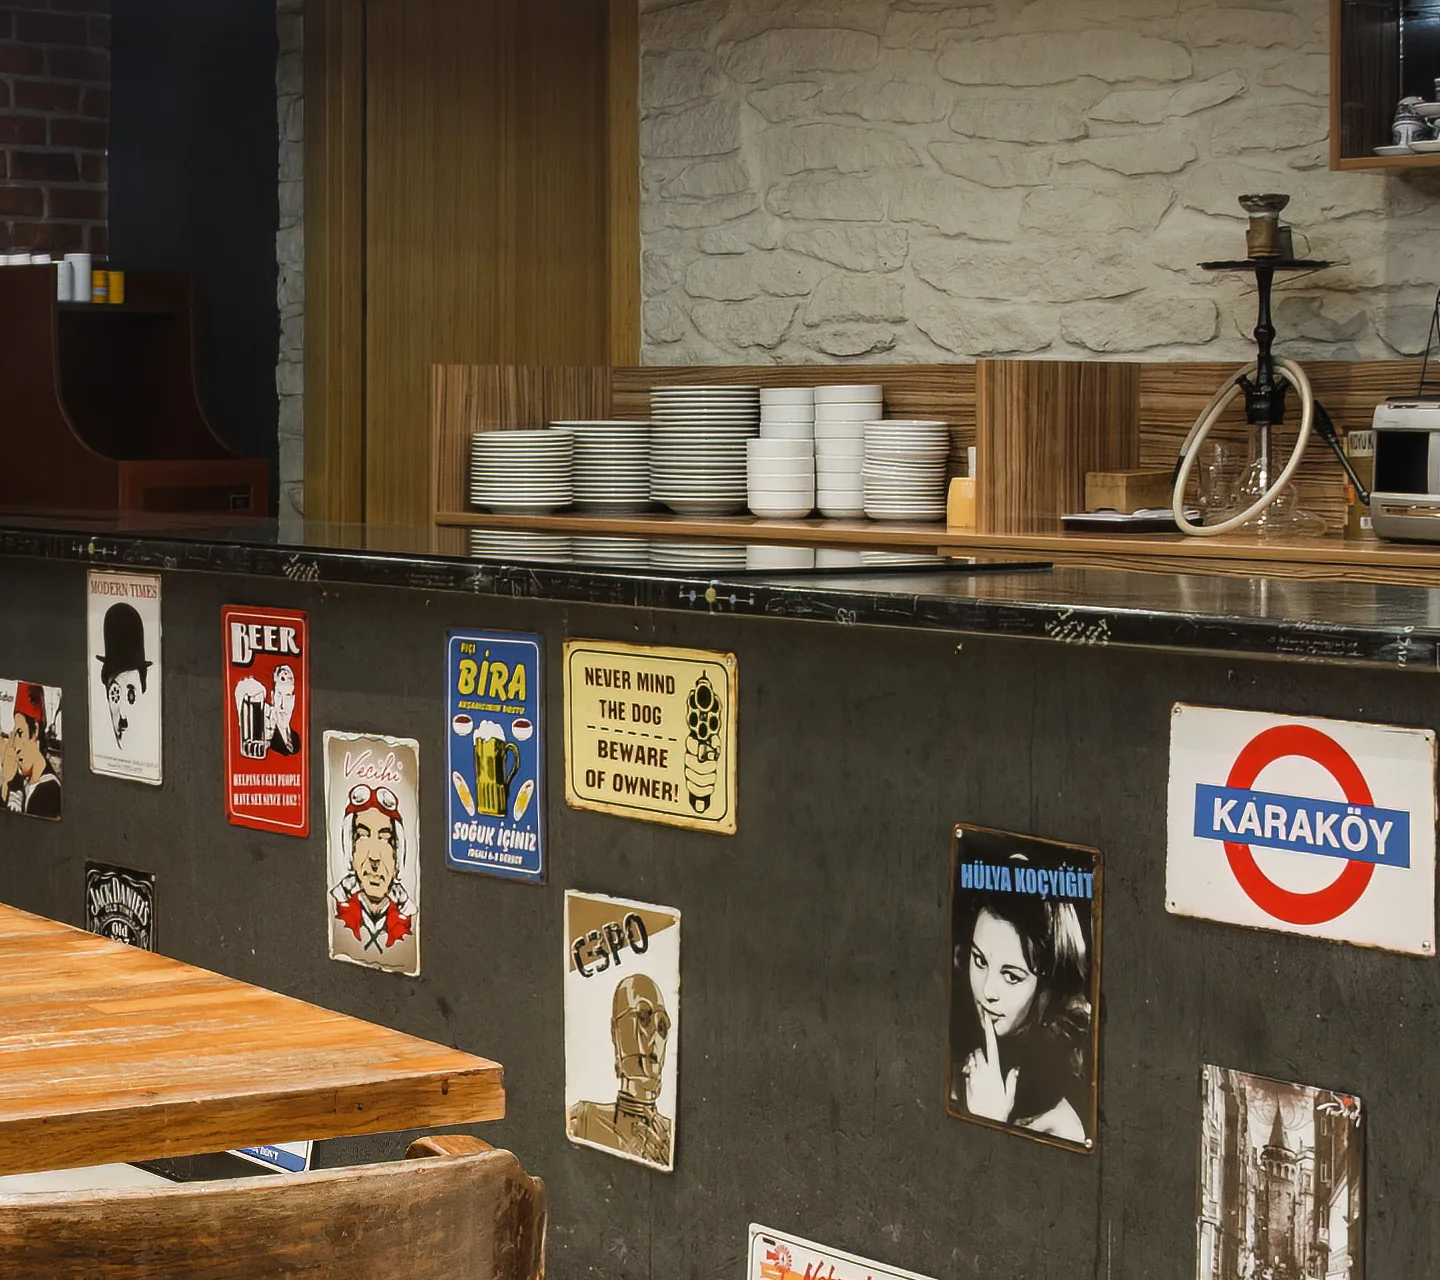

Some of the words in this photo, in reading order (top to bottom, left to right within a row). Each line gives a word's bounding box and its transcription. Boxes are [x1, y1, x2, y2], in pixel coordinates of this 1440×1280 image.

[90, 580, 129, 597] MODERN
[129, 583, 158, 599] TIMES
[230, 622, 300, 666] BEER
[457, 649, 527, 702] BİRA
[584, 666, 631, 691] NEVER
[637, 671, 676, 696] MIND
[599, 698, 626, 721] THE
[631, 702, 663, 726] DOG
[343, 749, 404, 784] Vecihi
[597, 739, 669, 769] BEWARE
[585, 768, 606, 789] OF
[612, 772, 680, 804] OWNER!
[452, 819, 496, 847] SOĞUK
[1212, 796, 1394, 856] KARAKÖY
[961, 859, 1013, 892] HÜLYA
[1013, 865, 1094, 900] KOÇYİĞİT
[111, 921, 128, 938] Old
[571, 911, 649, 979] C3PO
